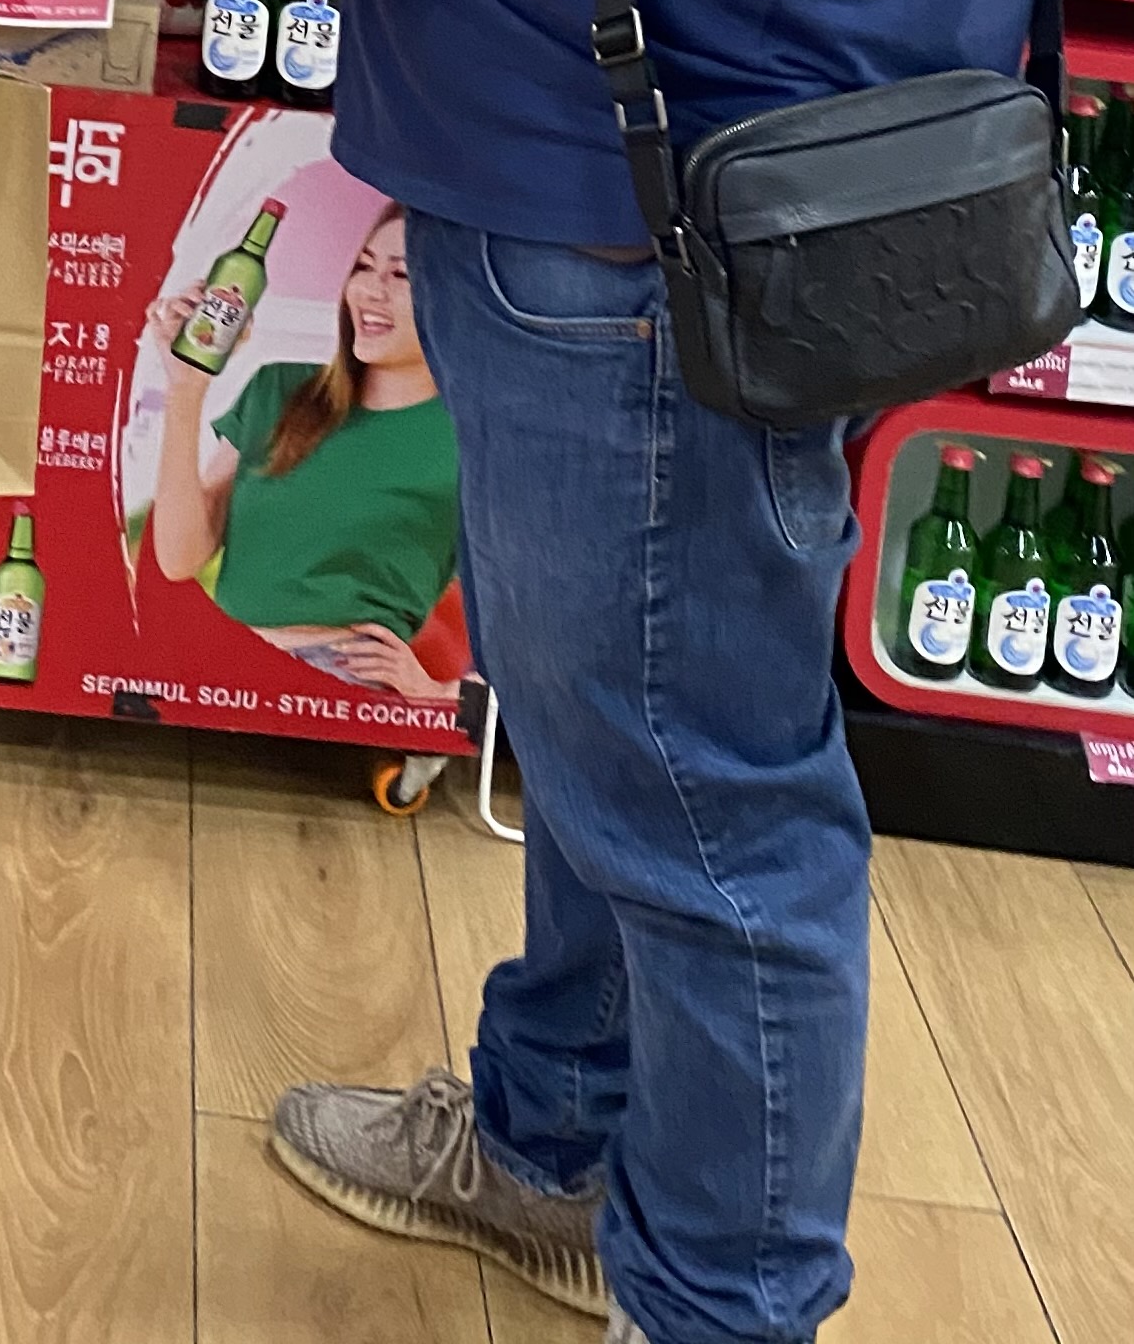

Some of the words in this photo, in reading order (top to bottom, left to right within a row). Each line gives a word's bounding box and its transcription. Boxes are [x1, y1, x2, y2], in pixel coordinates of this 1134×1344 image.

[211, 9, 260, 40] 선물
[287, 18, 336, 48] 선물
[55, 354, 107, 371] GRAPE
[53, 368, 106, 385] FRUIT
[38, 452, 104, 471] LUEBERRY
[81, 673, 191, 704] SEONMUL
[197, 684, 258, 711] SOJU
[277, 694, 351, 722] STYLE
